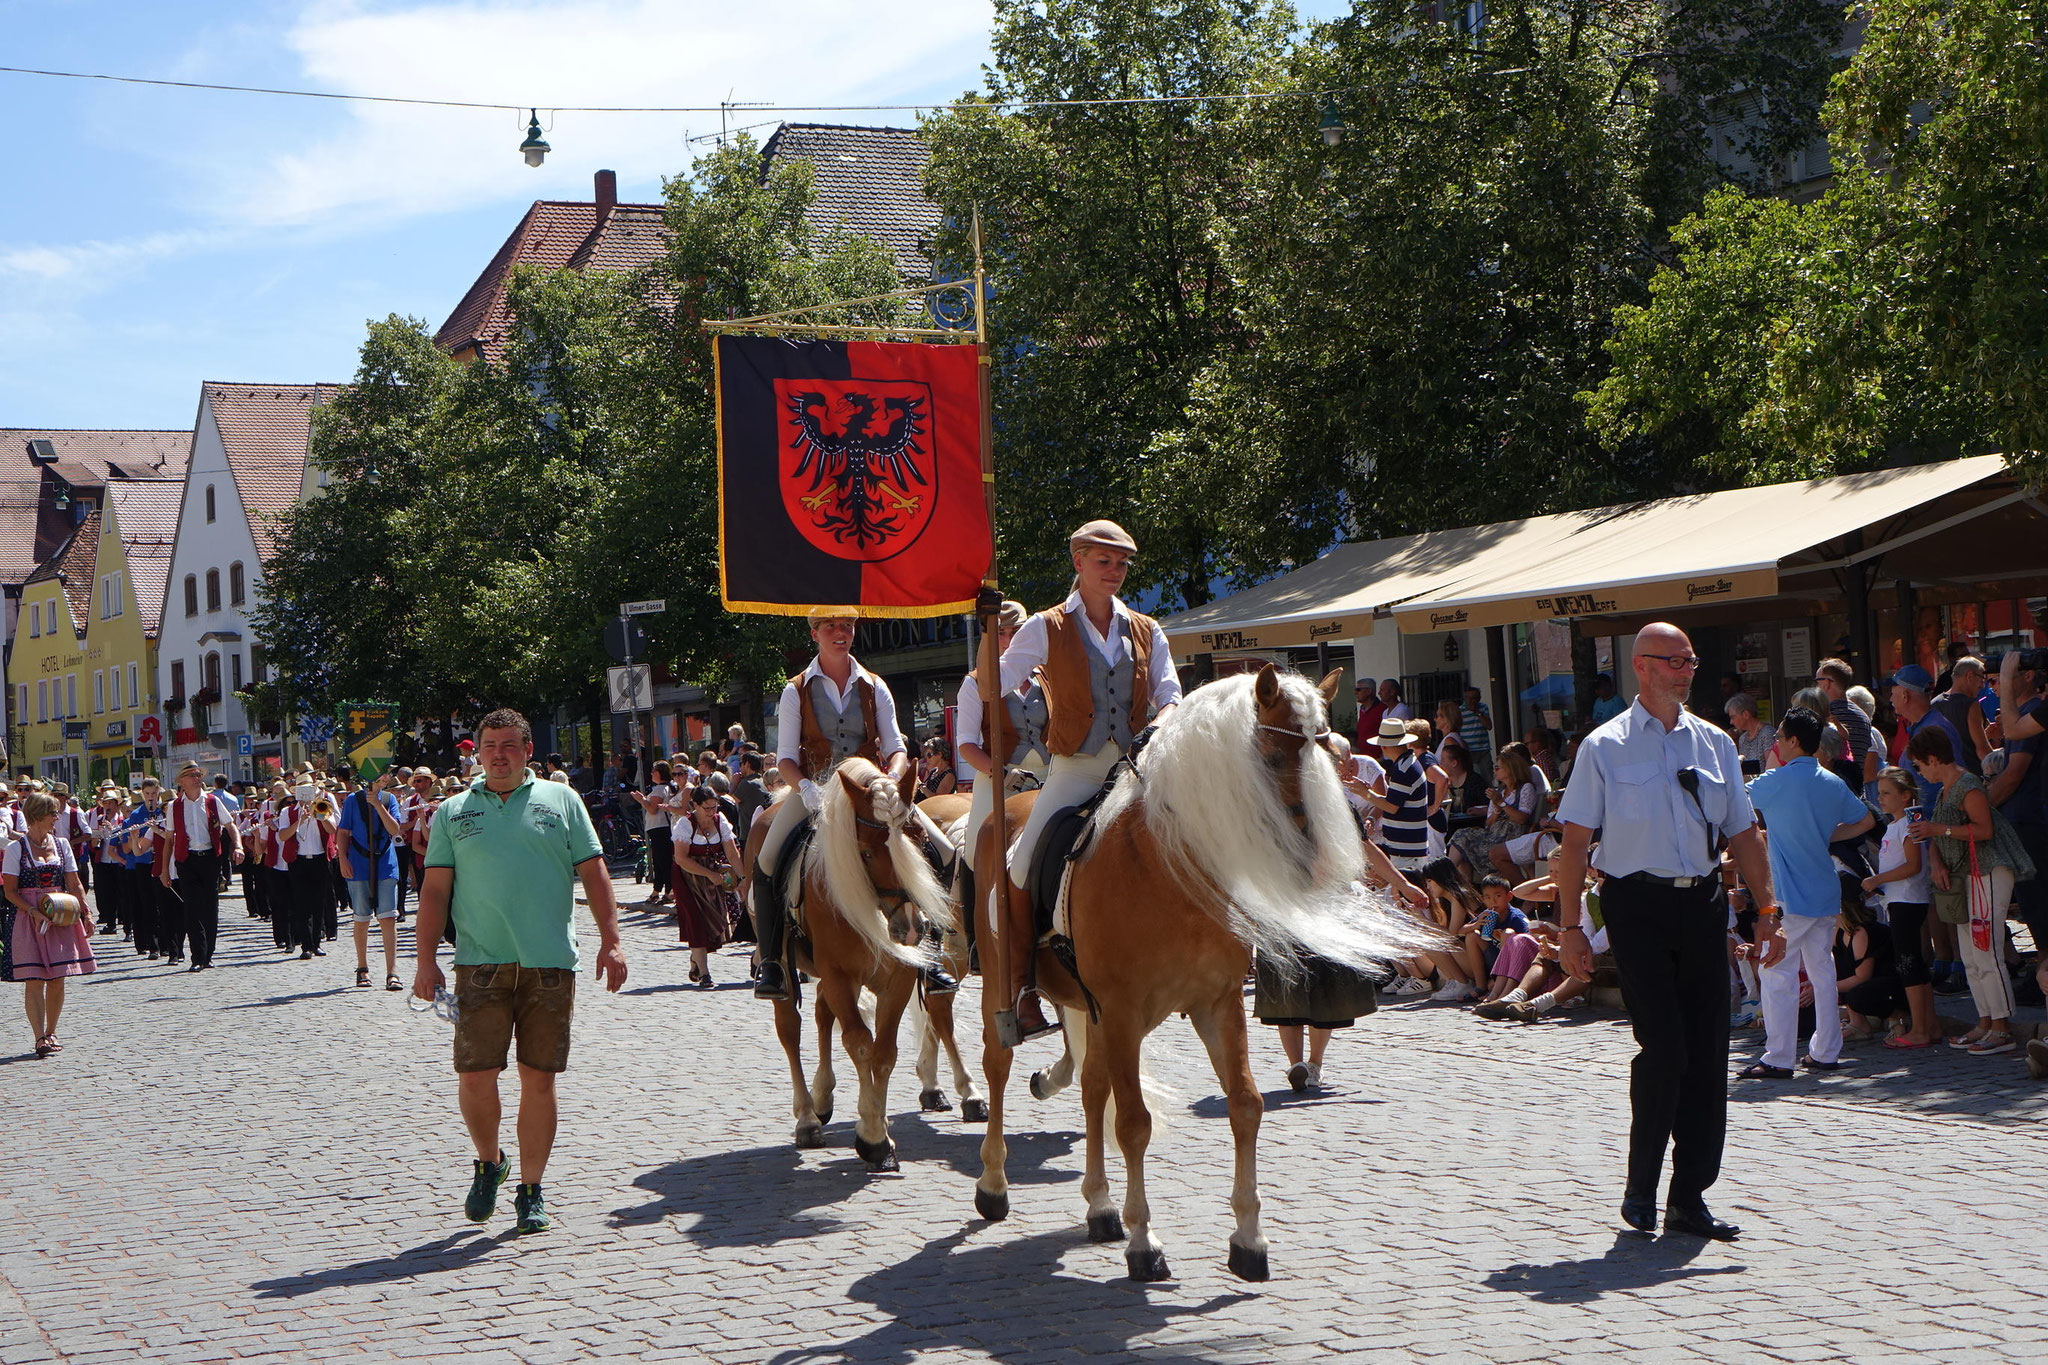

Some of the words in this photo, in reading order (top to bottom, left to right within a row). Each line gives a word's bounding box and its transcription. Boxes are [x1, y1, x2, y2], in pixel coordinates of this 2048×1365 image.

[646, 602, 662, 611] Gasse
[1536, 599, 1551, 609] EIS
[1551, 594, 1597, 615] LORENZO
[1595, 600, 1617, 611] CAFE
[860, 619, 921, 649] NTON
[1201, 635, 1212, 643] EIS
[1242, 638, 1258, 647] CAFE
[41, 655, 59, 673] HOTEL
[43, 740, 64, 753] Restaura
[450, 811, 485, 823] TERRITORY
